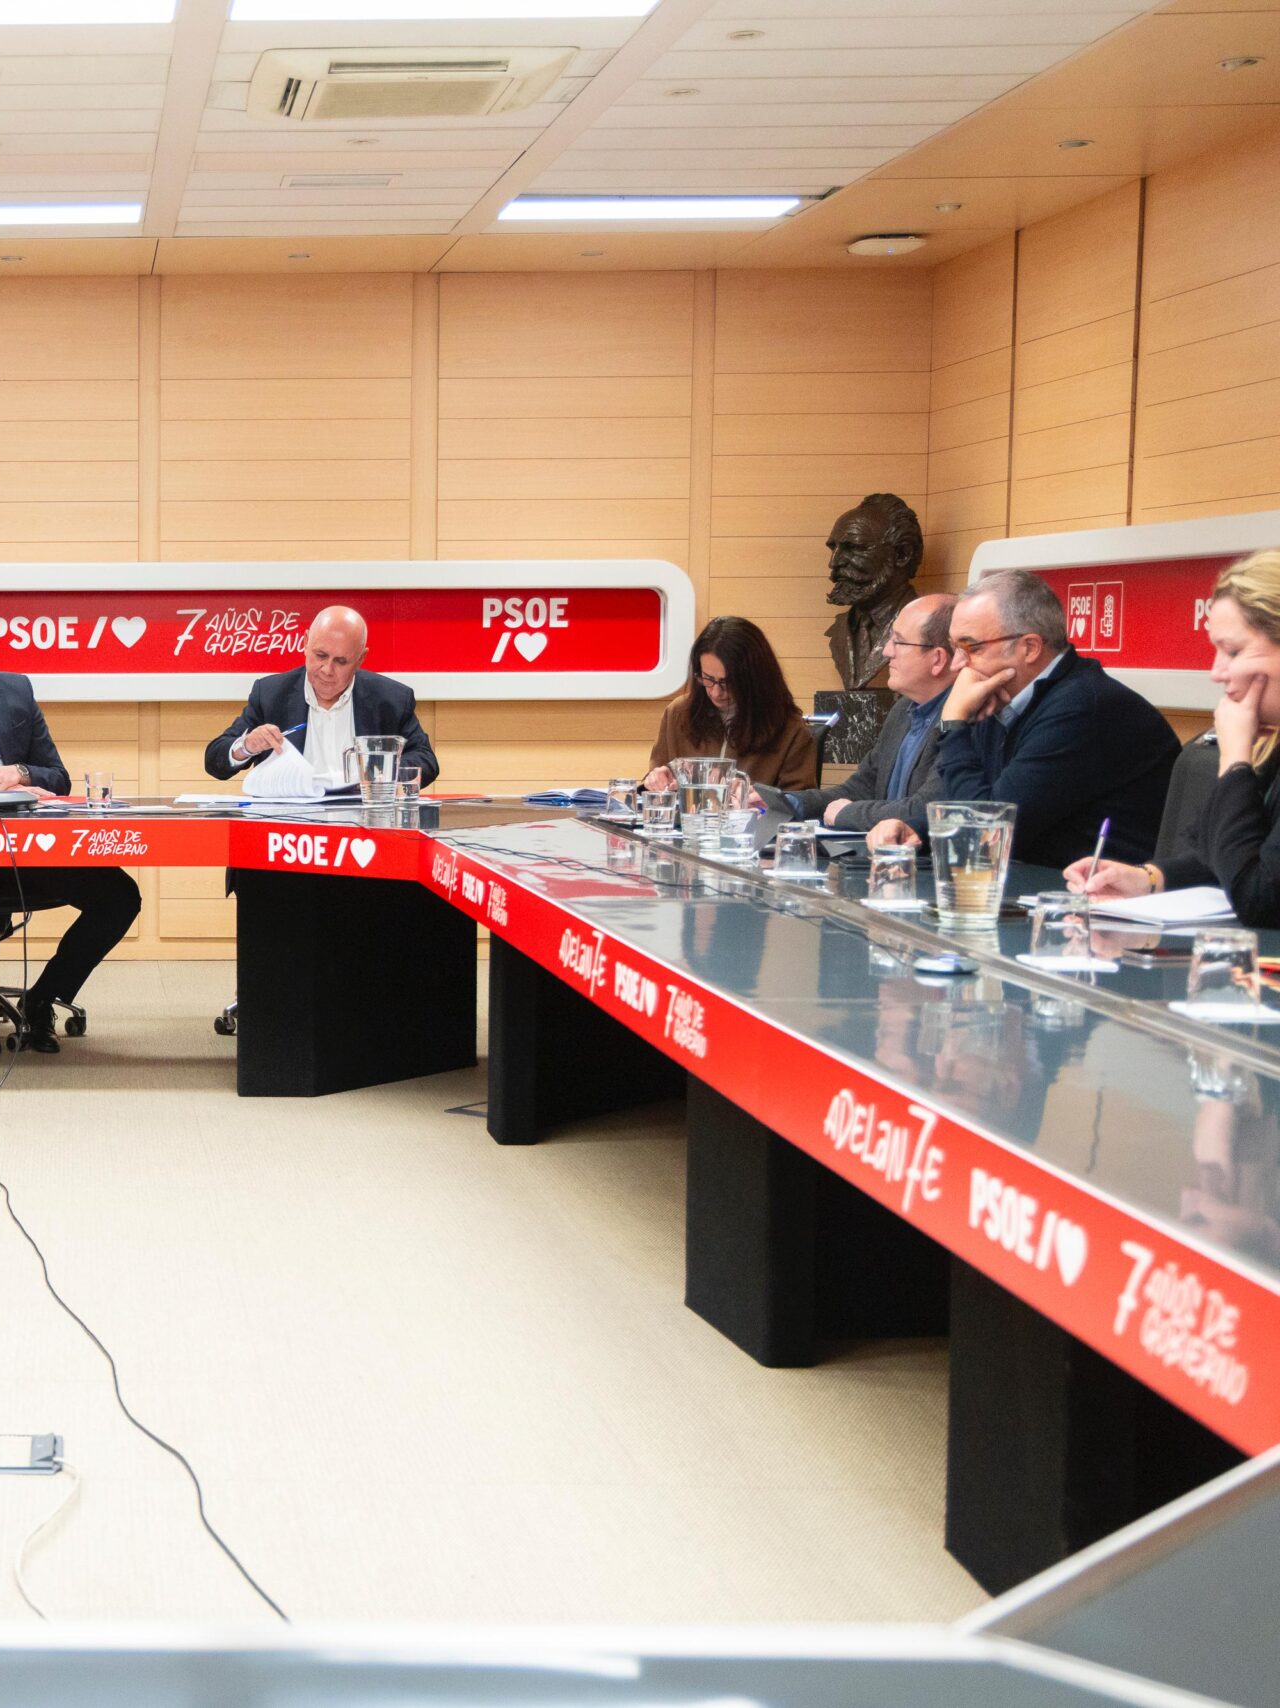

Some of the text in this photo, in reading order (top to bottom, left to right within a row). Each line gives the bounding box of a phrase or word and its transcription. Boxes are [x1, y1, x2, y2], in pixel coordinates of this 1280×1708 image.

[483, 597, 569, 629] PSOE
[1071, 596, 1092, 616] PSOE
[174, 608, 300, 656] 7 AÑOS DE
[71, 829, 90, 856] 7
[88, 829, 121, 844] AÑOS
[124, 829, 142, 844] DE
[88, 841, 148, 857] GOBIERNO
[268, 832, 328, 866] PSOE
[969, 1167, 1038, 1266] PSOE
[1113, 1240, 1155, 1336] 7
